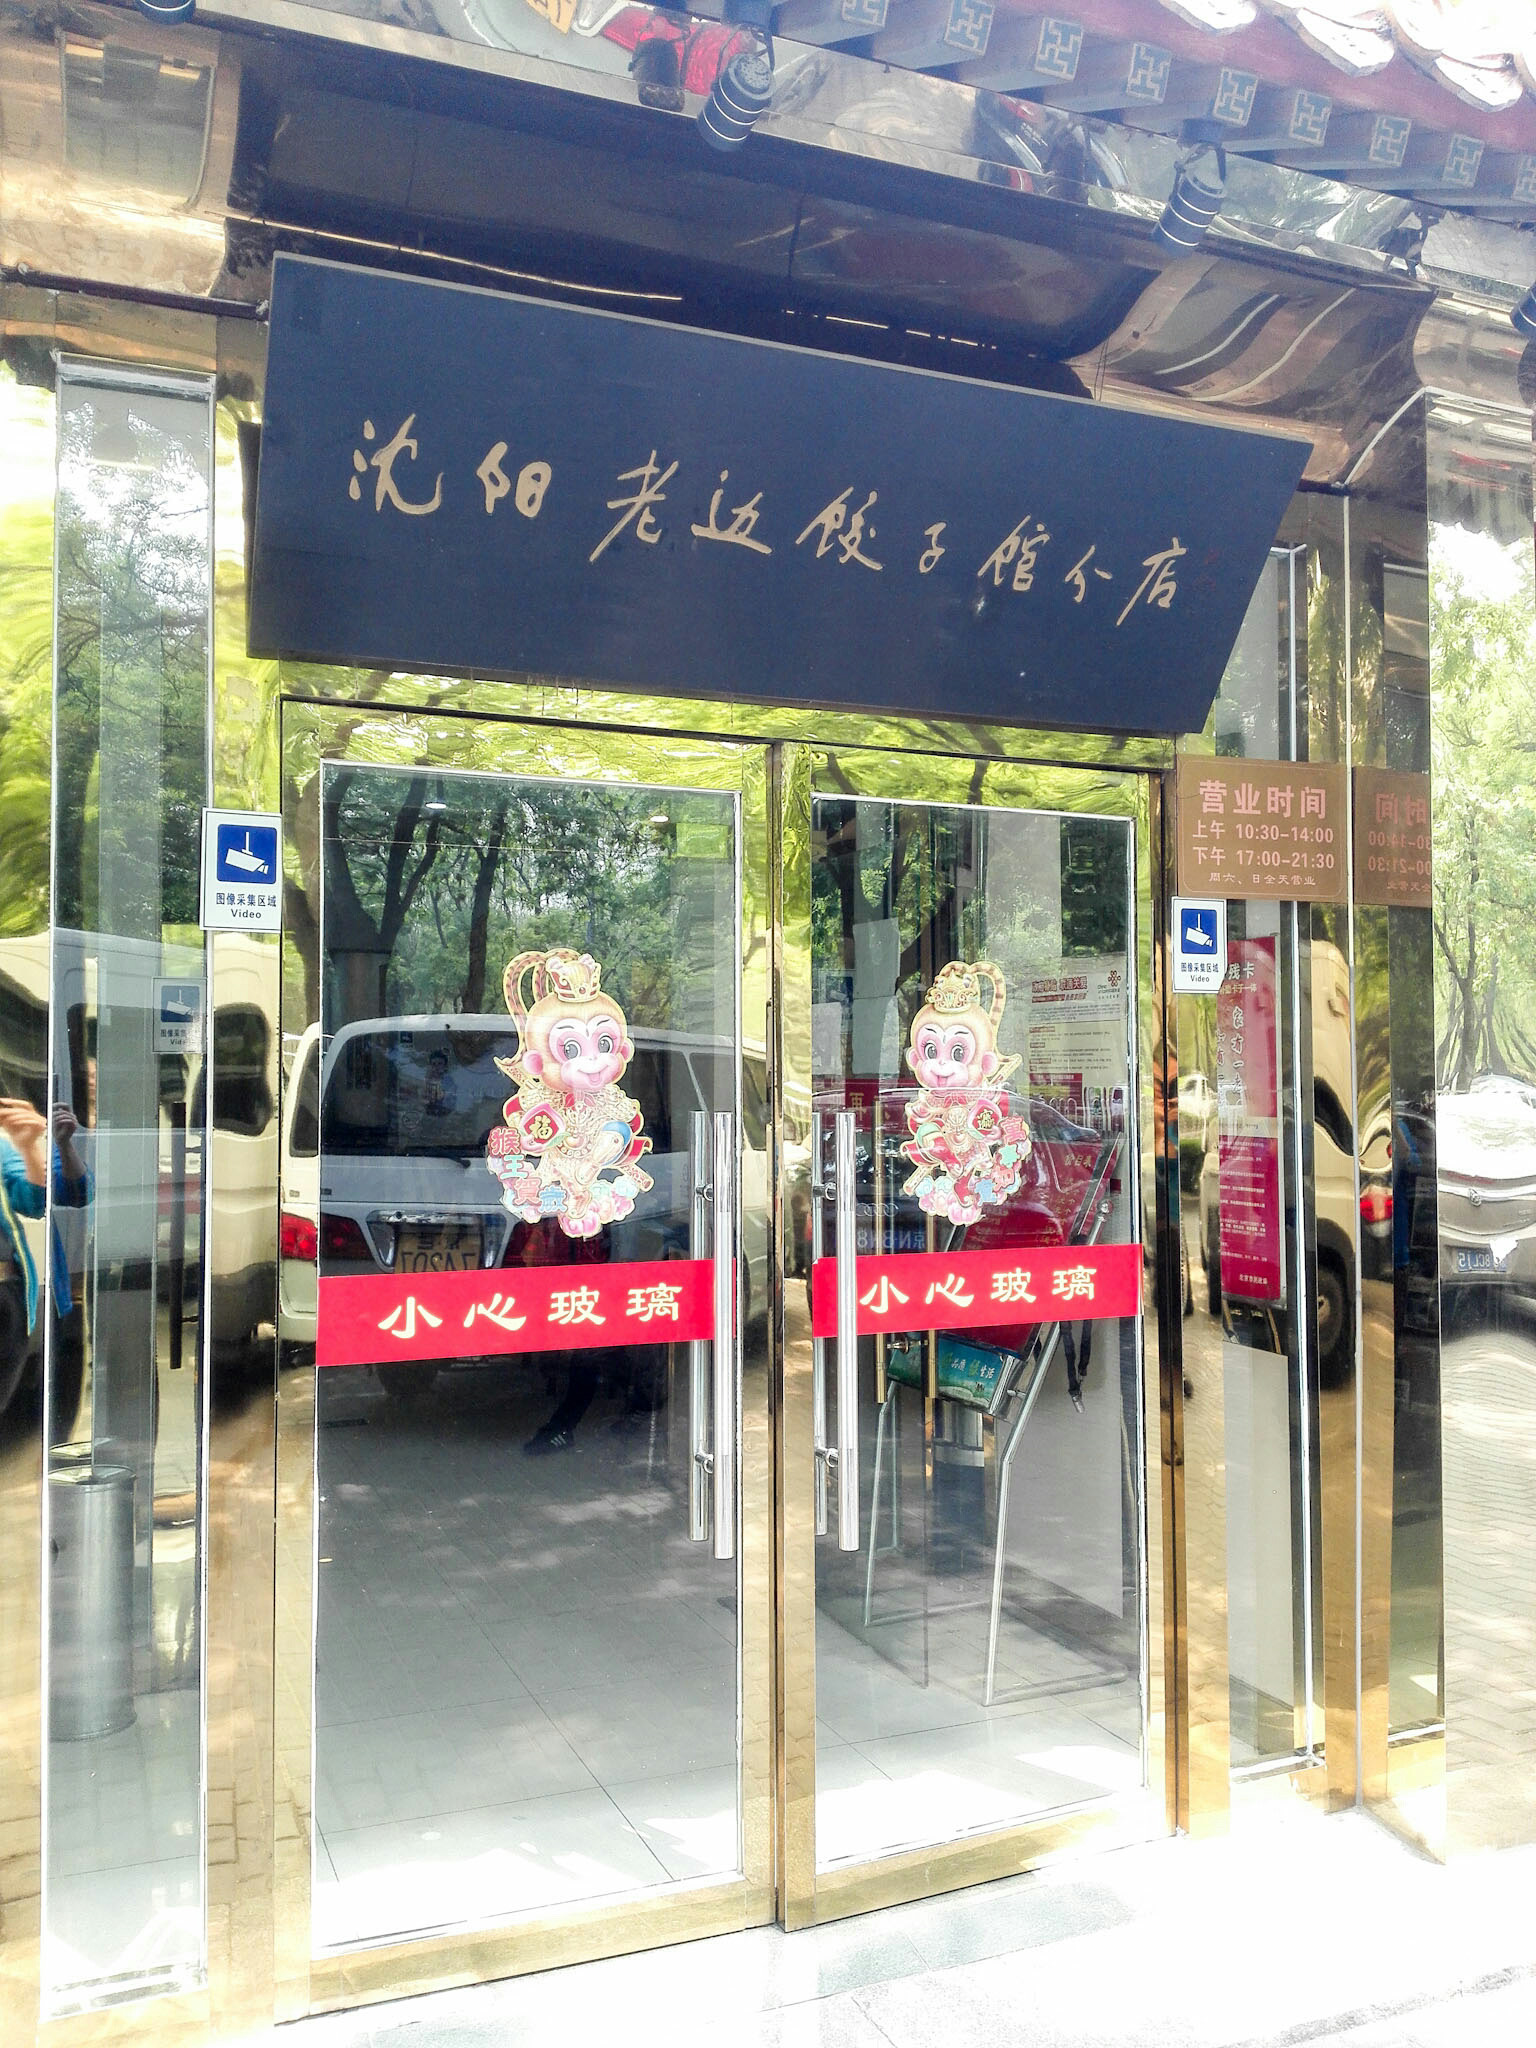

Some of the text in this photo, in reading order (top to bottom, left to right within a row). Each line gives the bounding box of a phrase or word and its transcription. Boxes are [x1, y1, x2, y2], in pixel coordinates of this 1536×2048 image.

[1199, 779, 1327, 819] 营业时间
[1192, 820, 1334, 844] 上午 10:30-14:00
[1192, 846, 1335, 869] 下午 17:00-21:30
[215, 892, 277, 907] 图像采集区域
[231, 909, 262, 919] Video
[1180, 962, 1219, 973] 图像采集区域
[1190, 975, 1210, 983] Video
[529, 1115, 554, 1140] 福
[860, 1265, 1097, 1314] 小心玻璃
[378, 1282, 683, 1339] 小心玻璃
